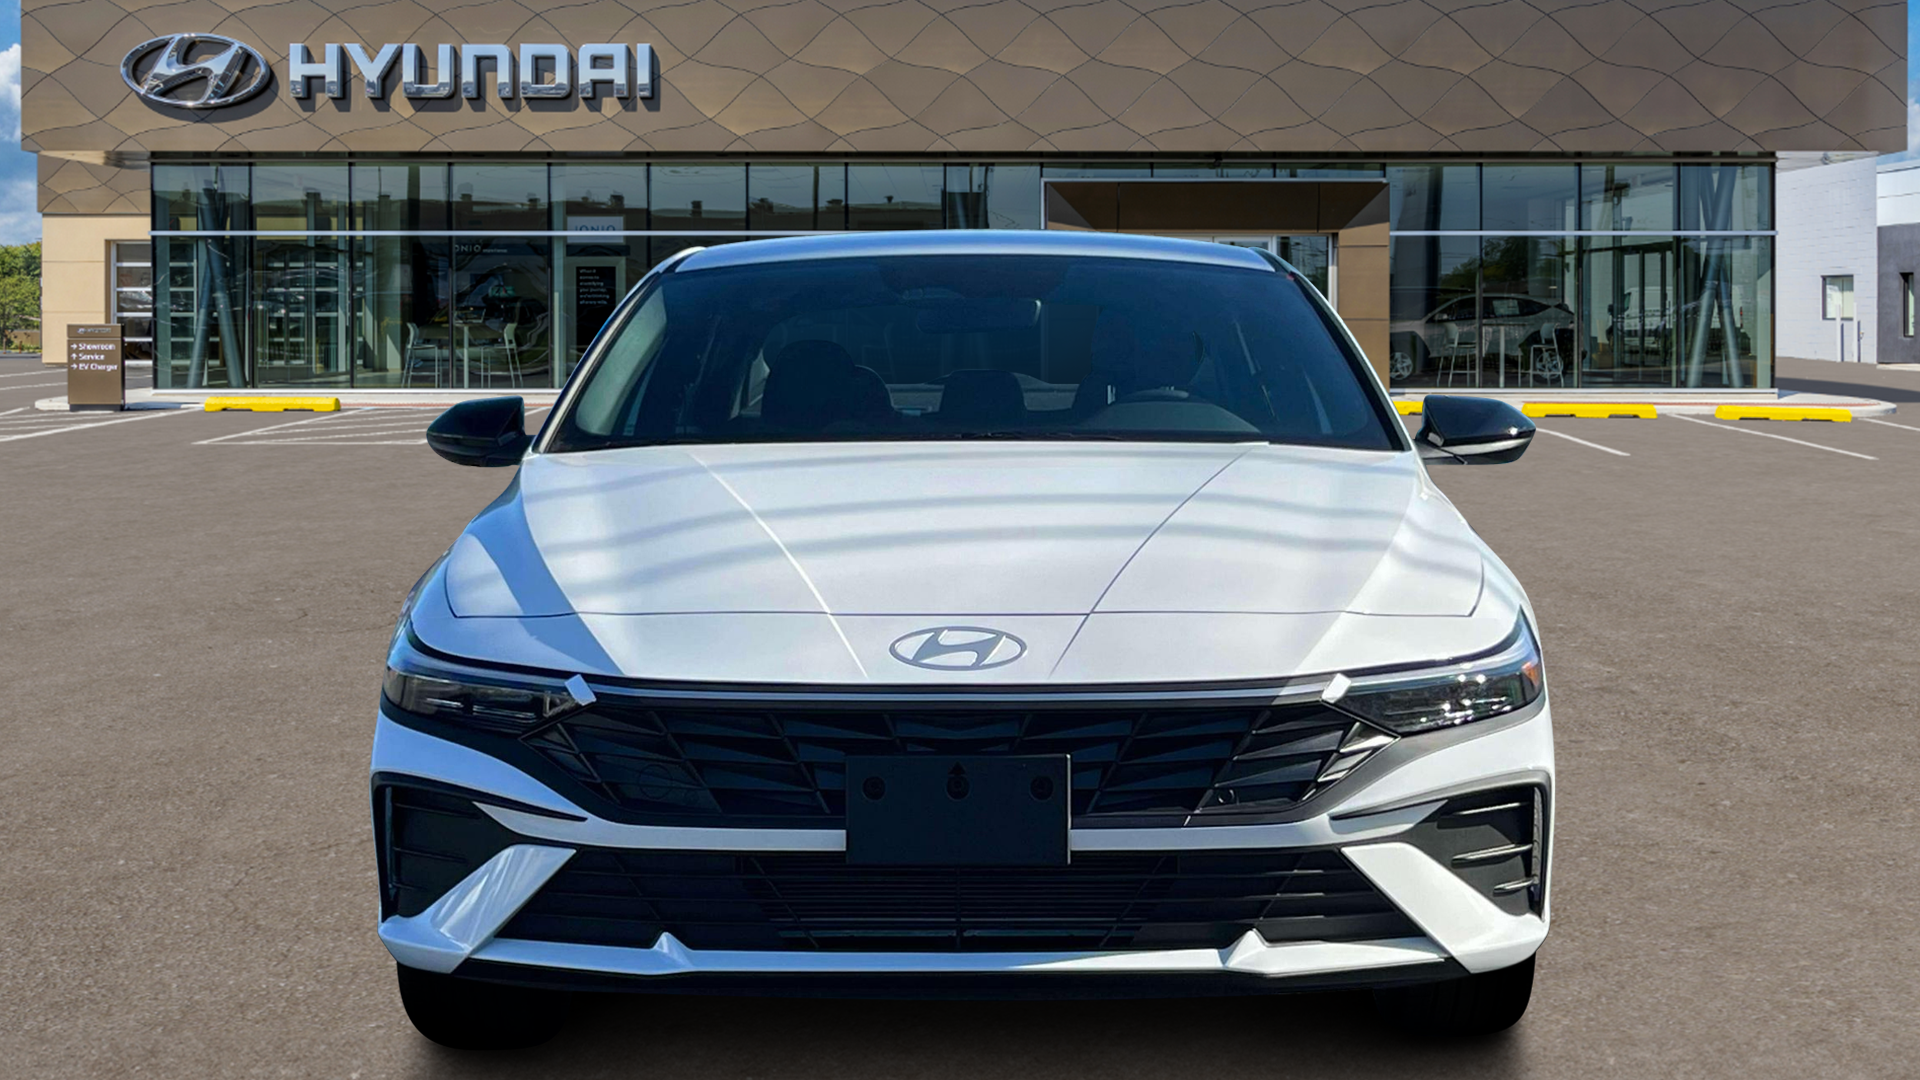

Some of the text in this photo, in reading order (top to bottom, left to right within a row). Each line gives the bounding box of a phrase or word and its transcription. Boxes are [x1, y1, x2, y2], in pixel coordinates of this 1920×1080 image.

[289, 43, 653, 99] HYUNDAI
[79, 343, 116, 351] Showroom
[90, 363, 118, 371] Charger
